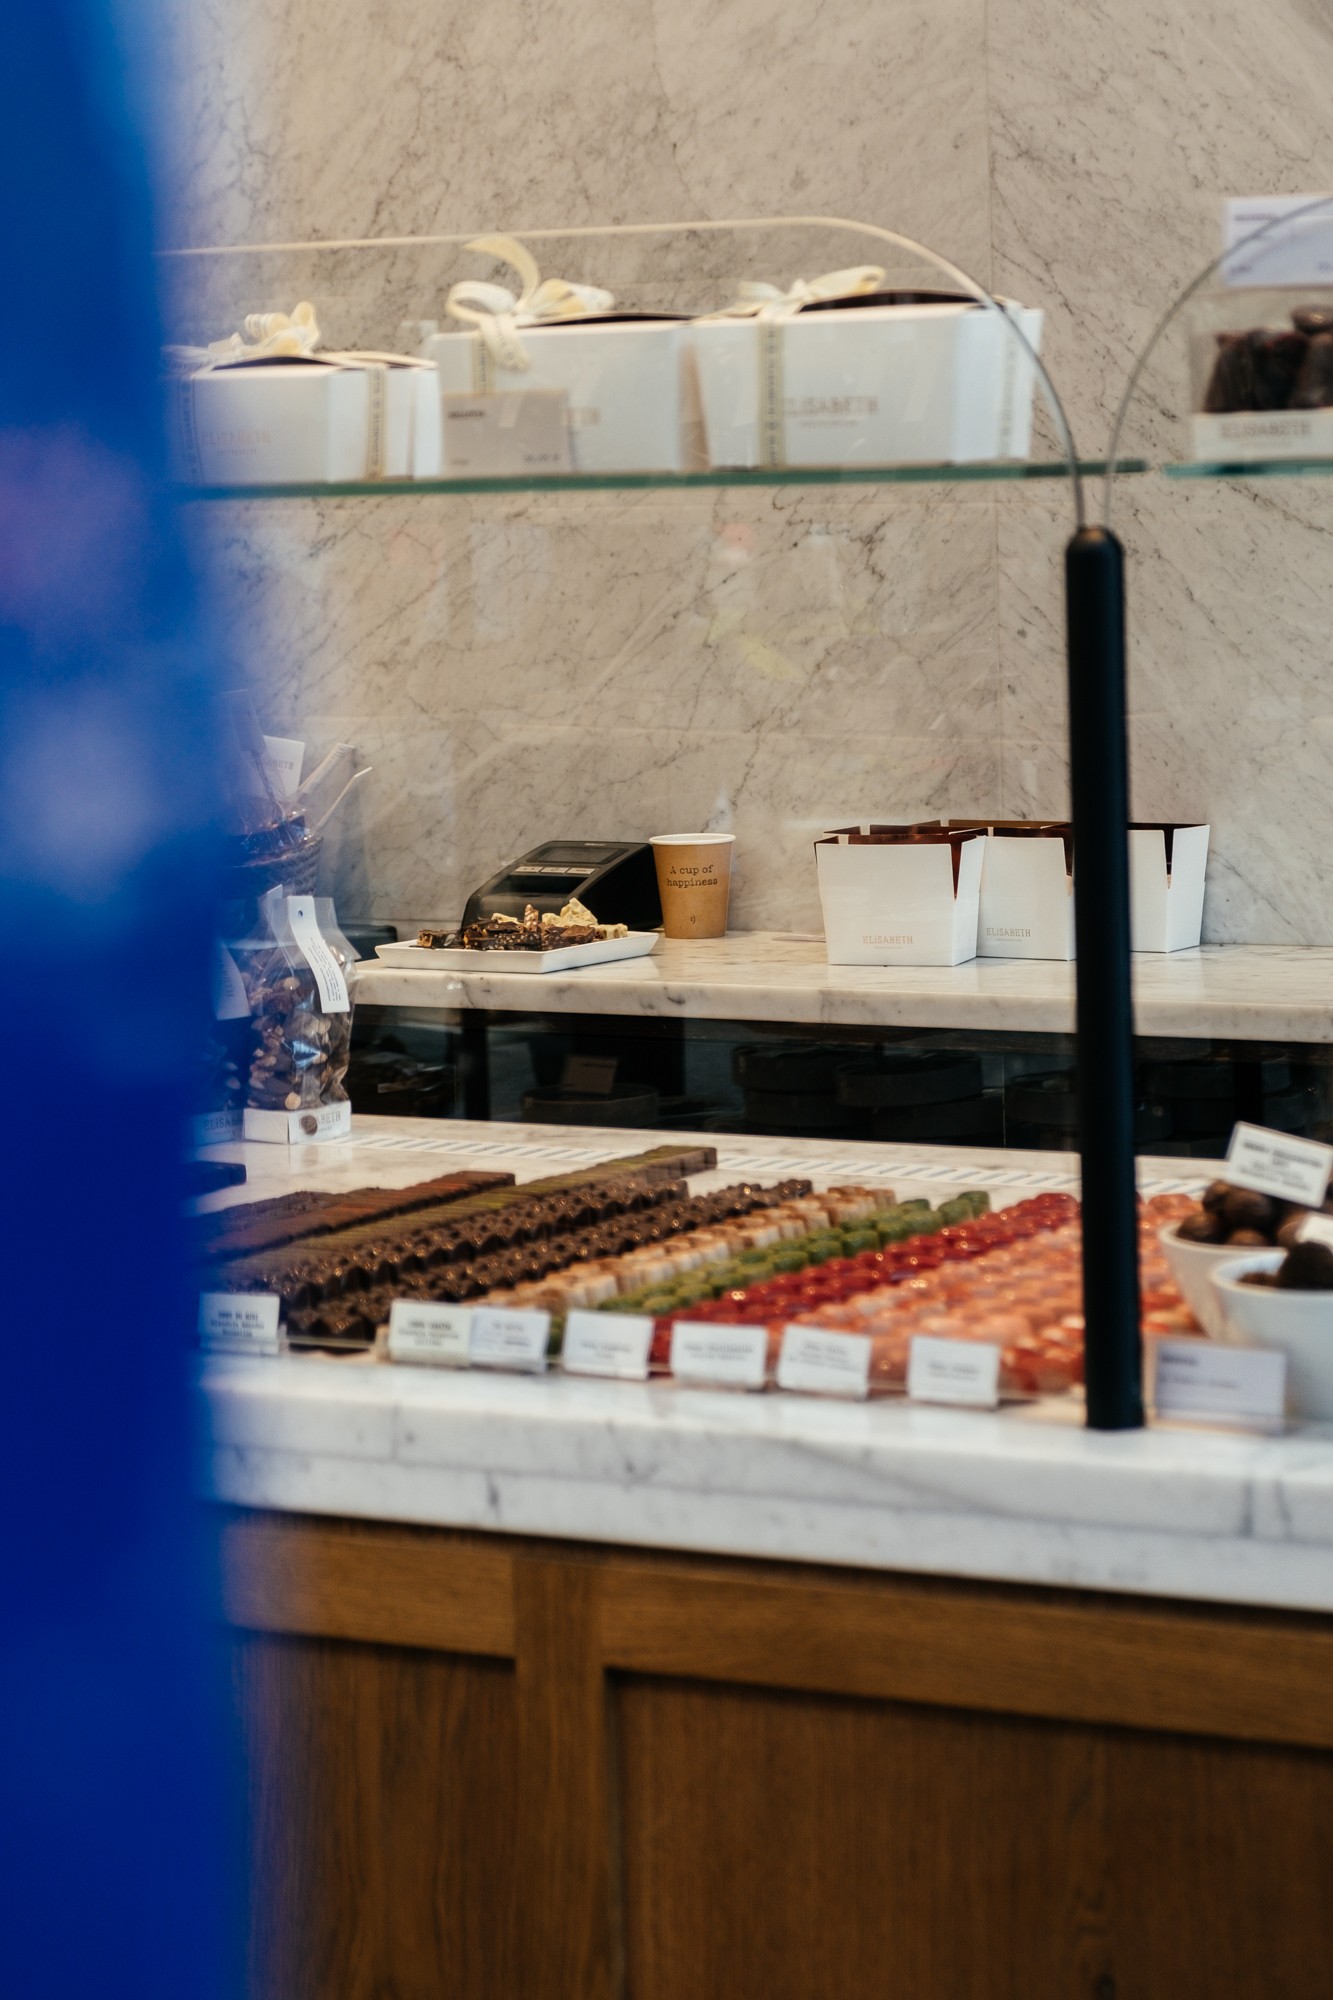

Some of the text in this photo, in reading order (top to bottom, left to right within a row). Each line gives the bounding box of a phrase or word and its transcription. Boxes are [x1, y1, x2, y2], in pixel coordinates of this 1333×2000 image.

[670, 864, 714, 876] A cup of
[666, 878, 718, 888] happiness
[862, 935, 914, 945] ELISABETH
